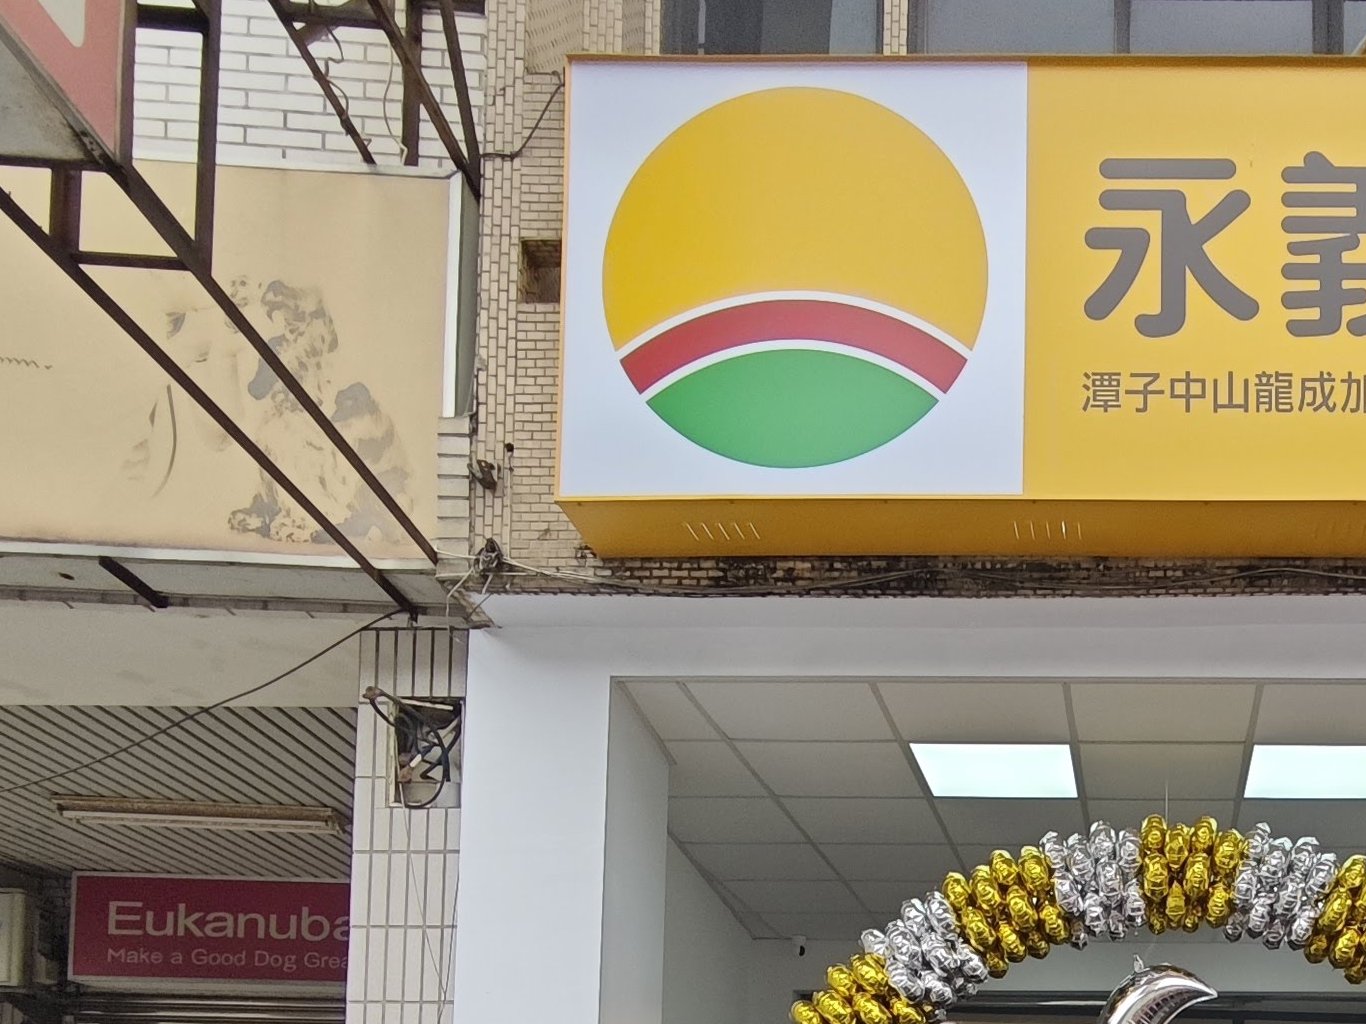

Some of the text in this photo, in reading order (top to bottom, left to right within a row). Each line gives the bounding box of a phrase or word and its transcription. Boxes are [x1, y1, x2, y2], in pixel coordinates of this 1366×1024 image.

[107, 948, 163, 965] Make
[170, 953, 183, 966] a
[191, 949, 246, 966] Good
[254, 950, 296, 972] Dog
